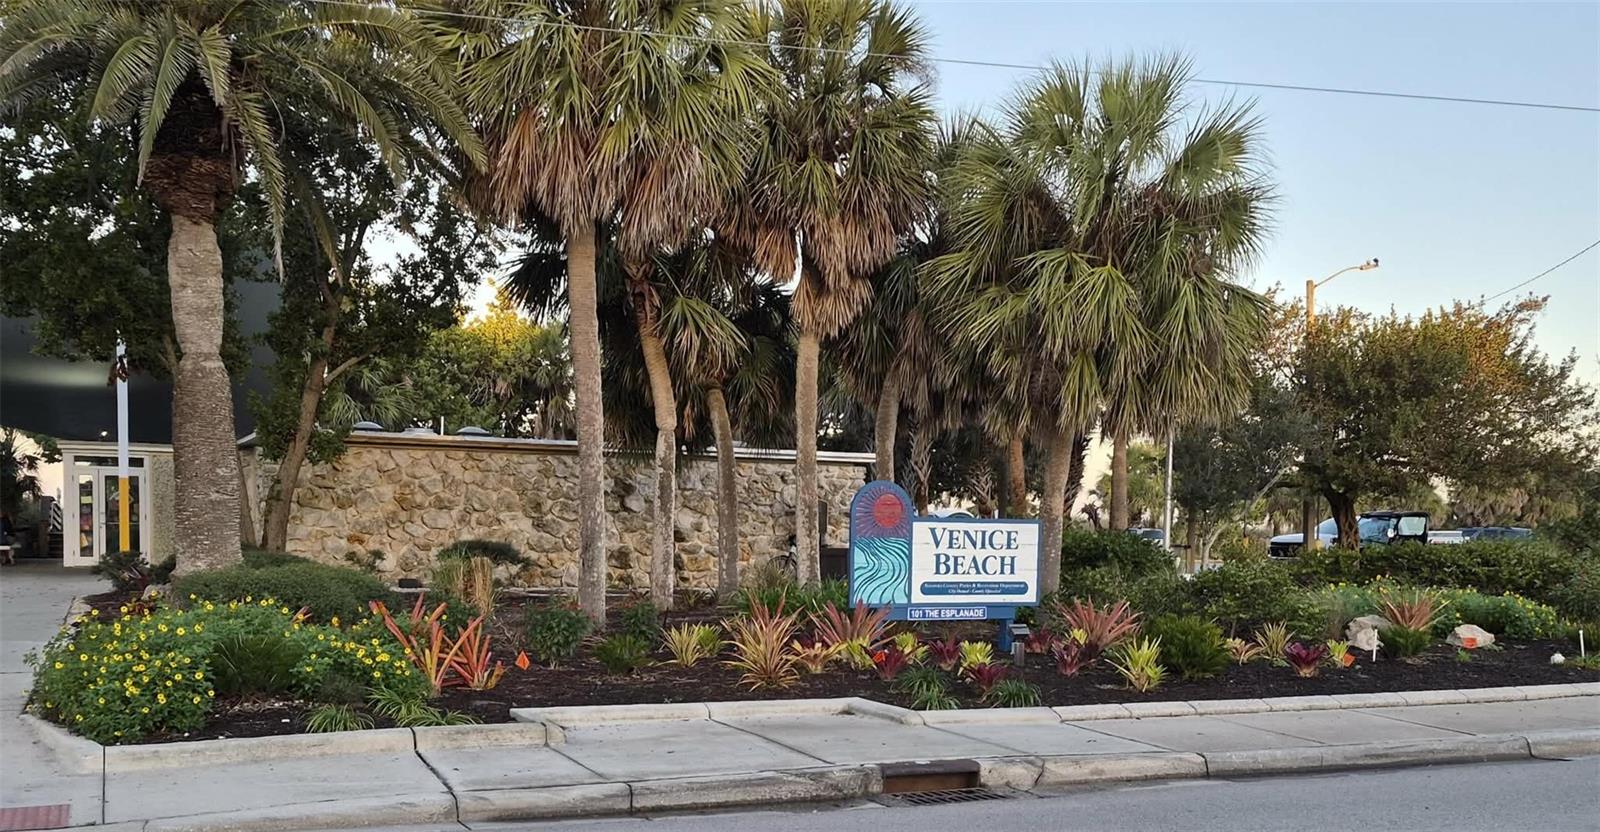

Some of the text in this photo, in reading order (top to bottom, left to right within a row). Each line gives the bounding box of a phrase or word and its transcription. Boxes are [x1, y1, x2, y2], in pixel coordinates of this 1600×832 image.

[928, 527, 1019, 550] VENICE
[933, 553, 1017, 575] BEACH
[911, 608, 984, 618] 101 THE ESPLANADE
